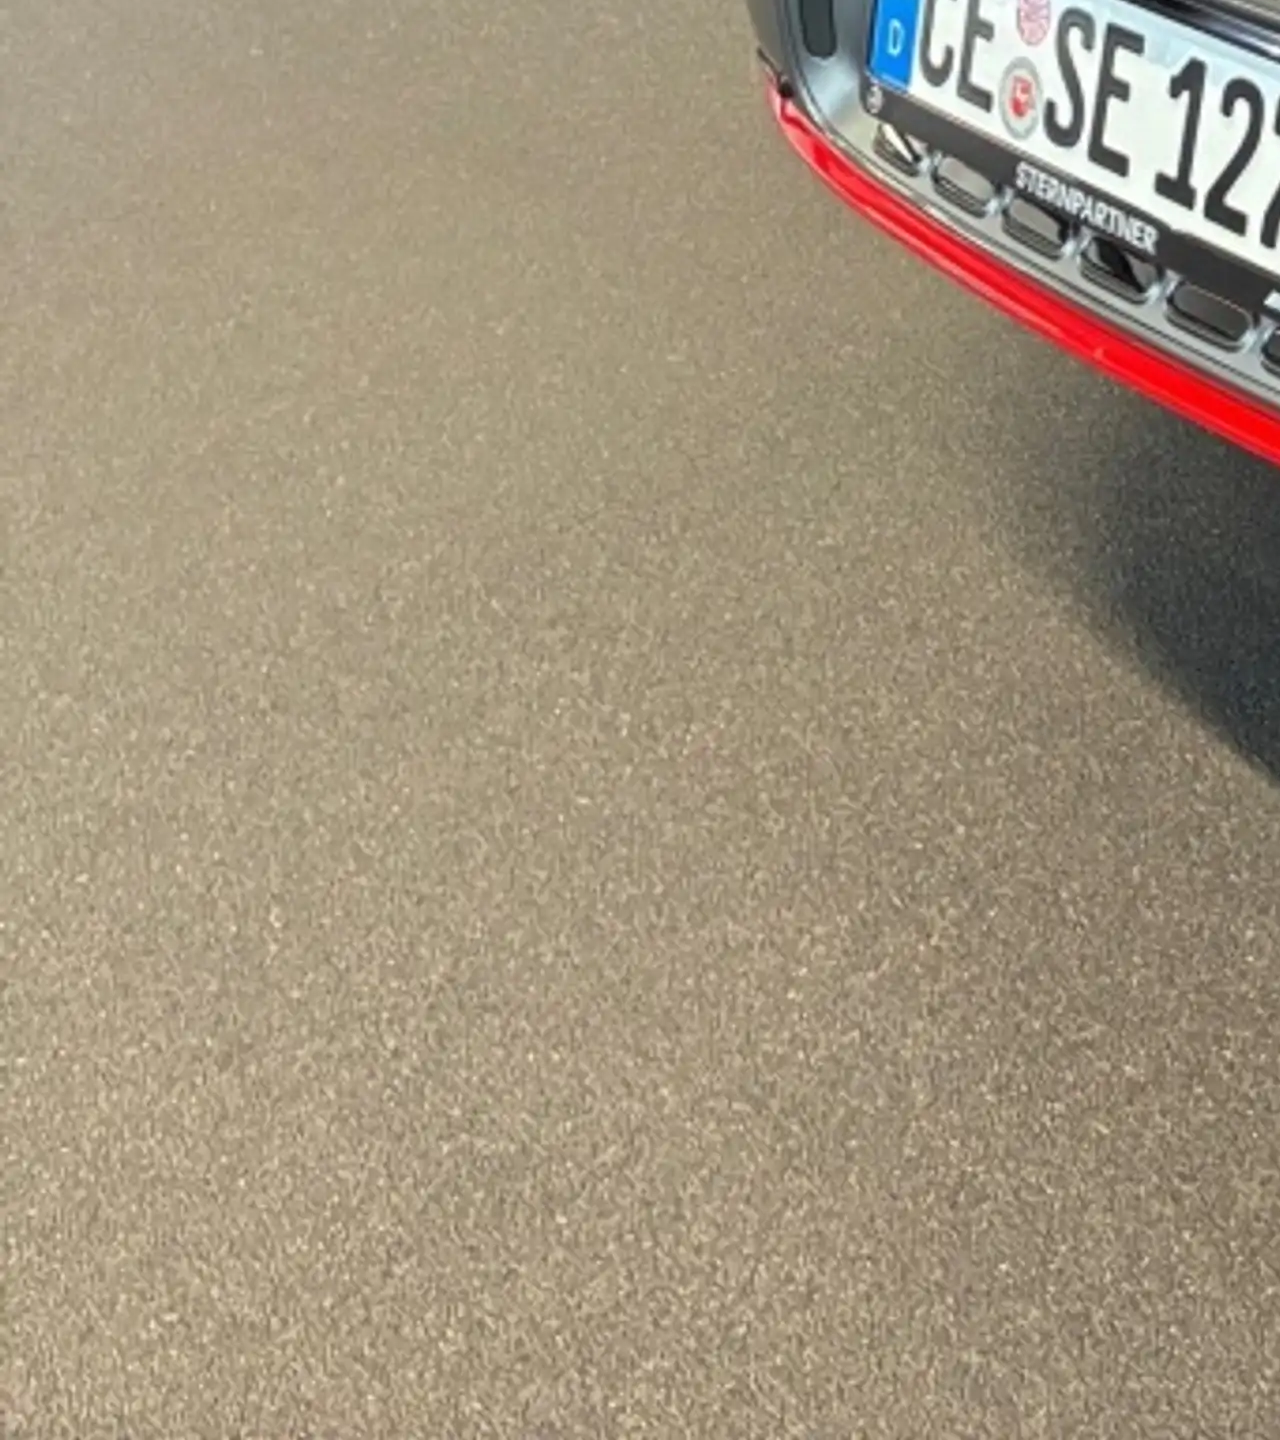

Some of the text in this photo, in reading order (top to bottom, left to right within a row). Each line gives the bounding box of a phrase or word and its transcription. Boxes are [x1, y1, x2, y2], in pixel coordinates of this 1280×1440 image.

[886, 18, 905, 56] D
[1043, 6, 1146, 178] SE
[1015, 161, 1160, 255] STERNPARTNER
